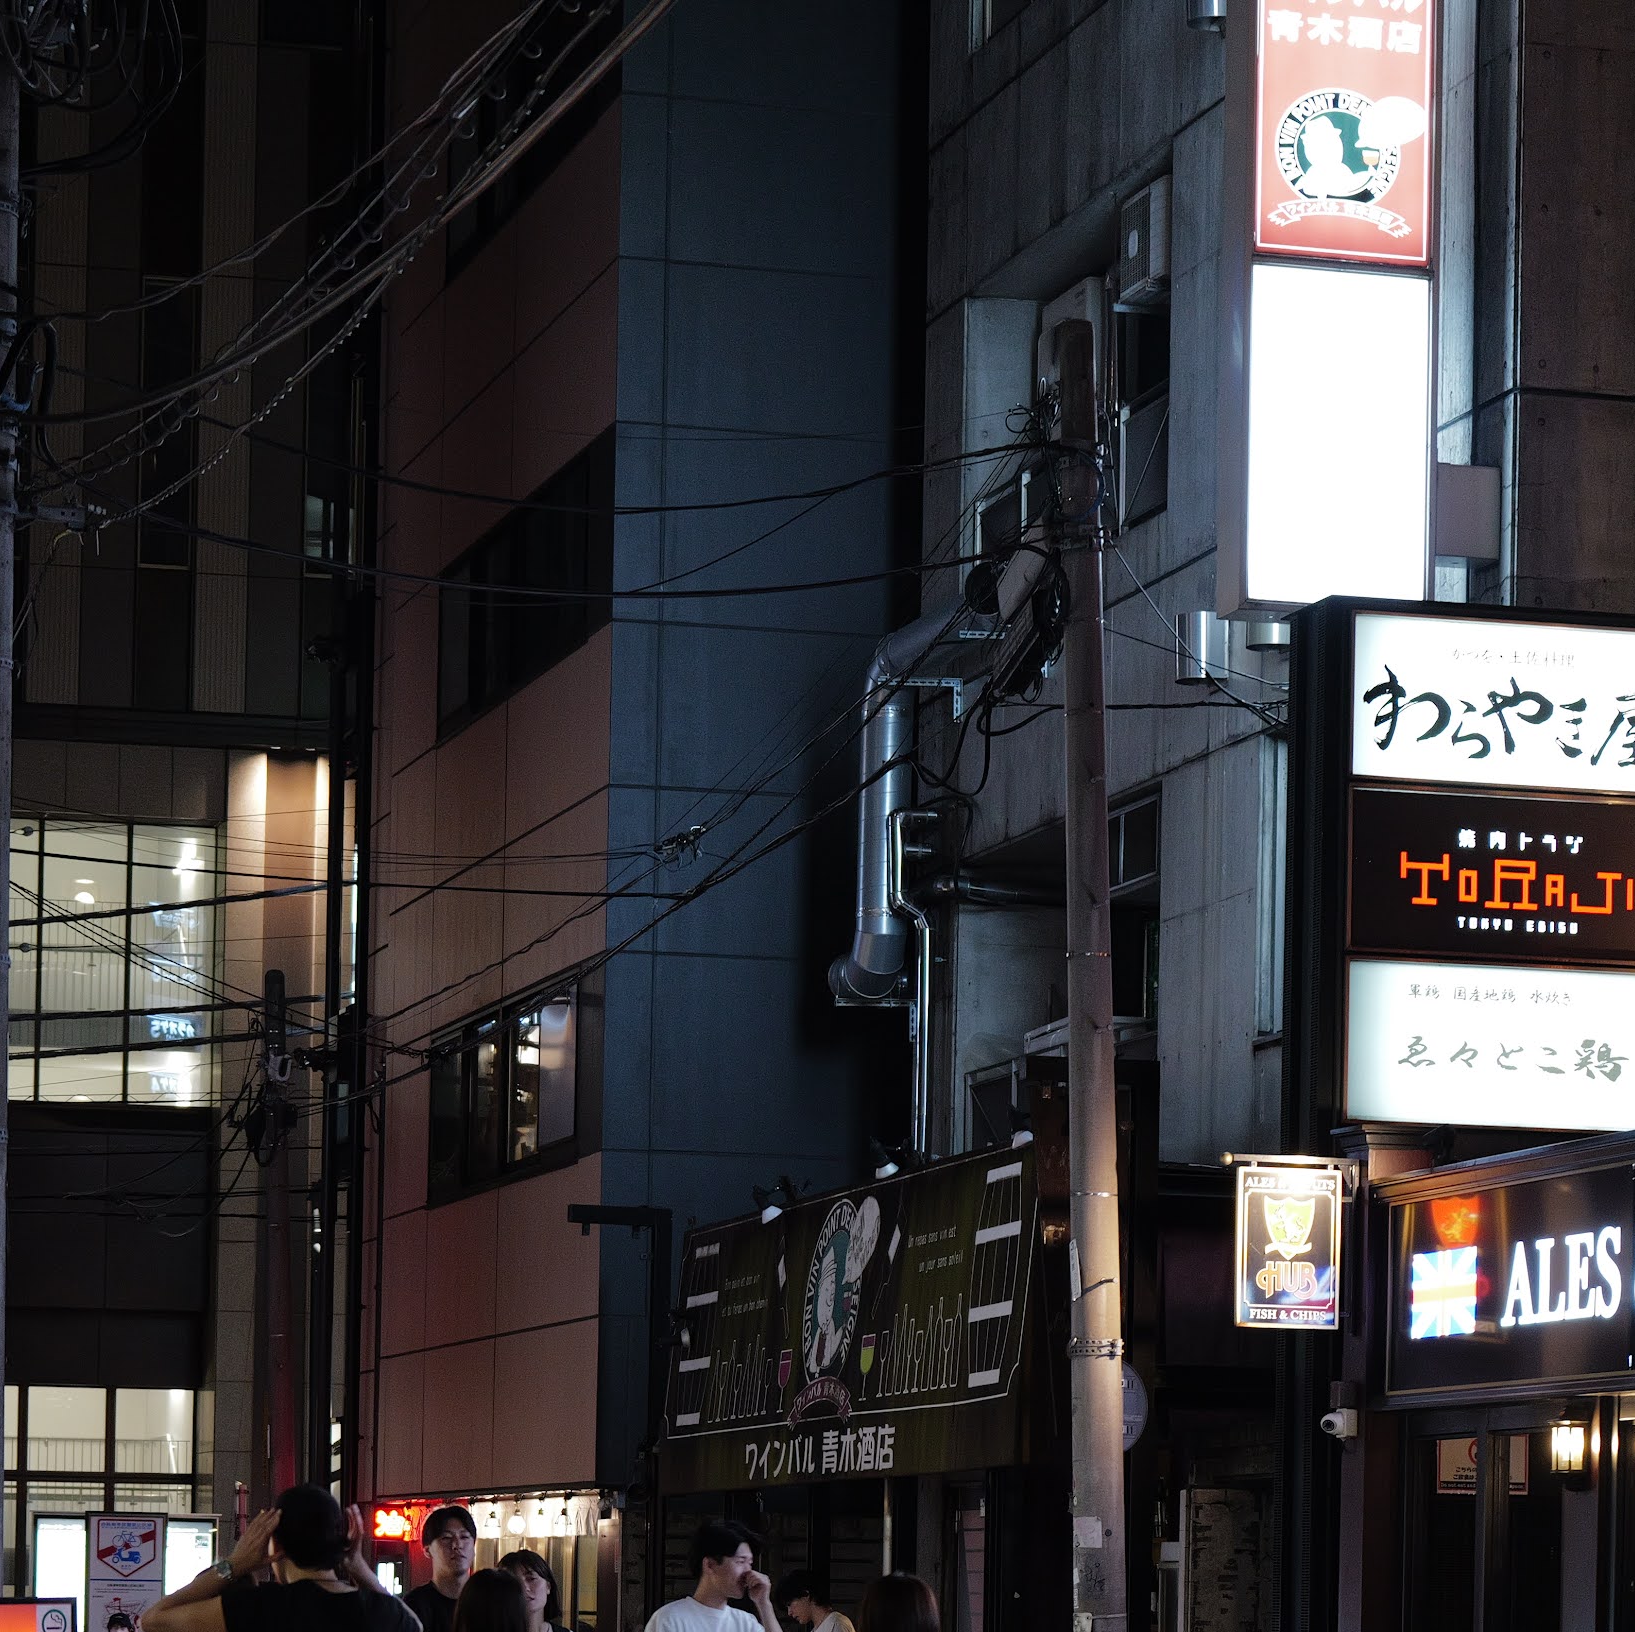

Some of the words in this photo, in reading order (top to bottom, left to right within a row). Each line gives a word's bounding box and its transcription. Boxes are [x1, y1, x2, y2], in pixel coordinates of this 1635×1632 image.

[1268, 9, 1422, 54] 青木酒店
[1292, 93, 1335, 122] POINT
[1400, 851, 1634, 914] TORAJI
[1458, 916, 1513, 931] TOKYO
[1526, 920, 1579, 935] EBISU
[1453, 986, 1516, 1003] 国産地鶏
[1529, 988, 1572, 1006] 水炊き
[1245, 1176, 1276, 1188] ALES
[818, 1208, 842, 1257] POINT
[807, 1259, 820, 1298] VIN
[1256, 1261, 1318, 1300] HUB
[1501, 1226, 1623, 1328] ALES
[804, 1308, 814, 1354] BON
[1249, 1309, 1277, 1320] FISH
[1279, 1310, 1288, 1320] &
[1290, 1310, 1327, 1321] CHIPS
[745, 1435, 816, 1480] ワインバル
[821, 1424, 896, 1475] 青木酒店
